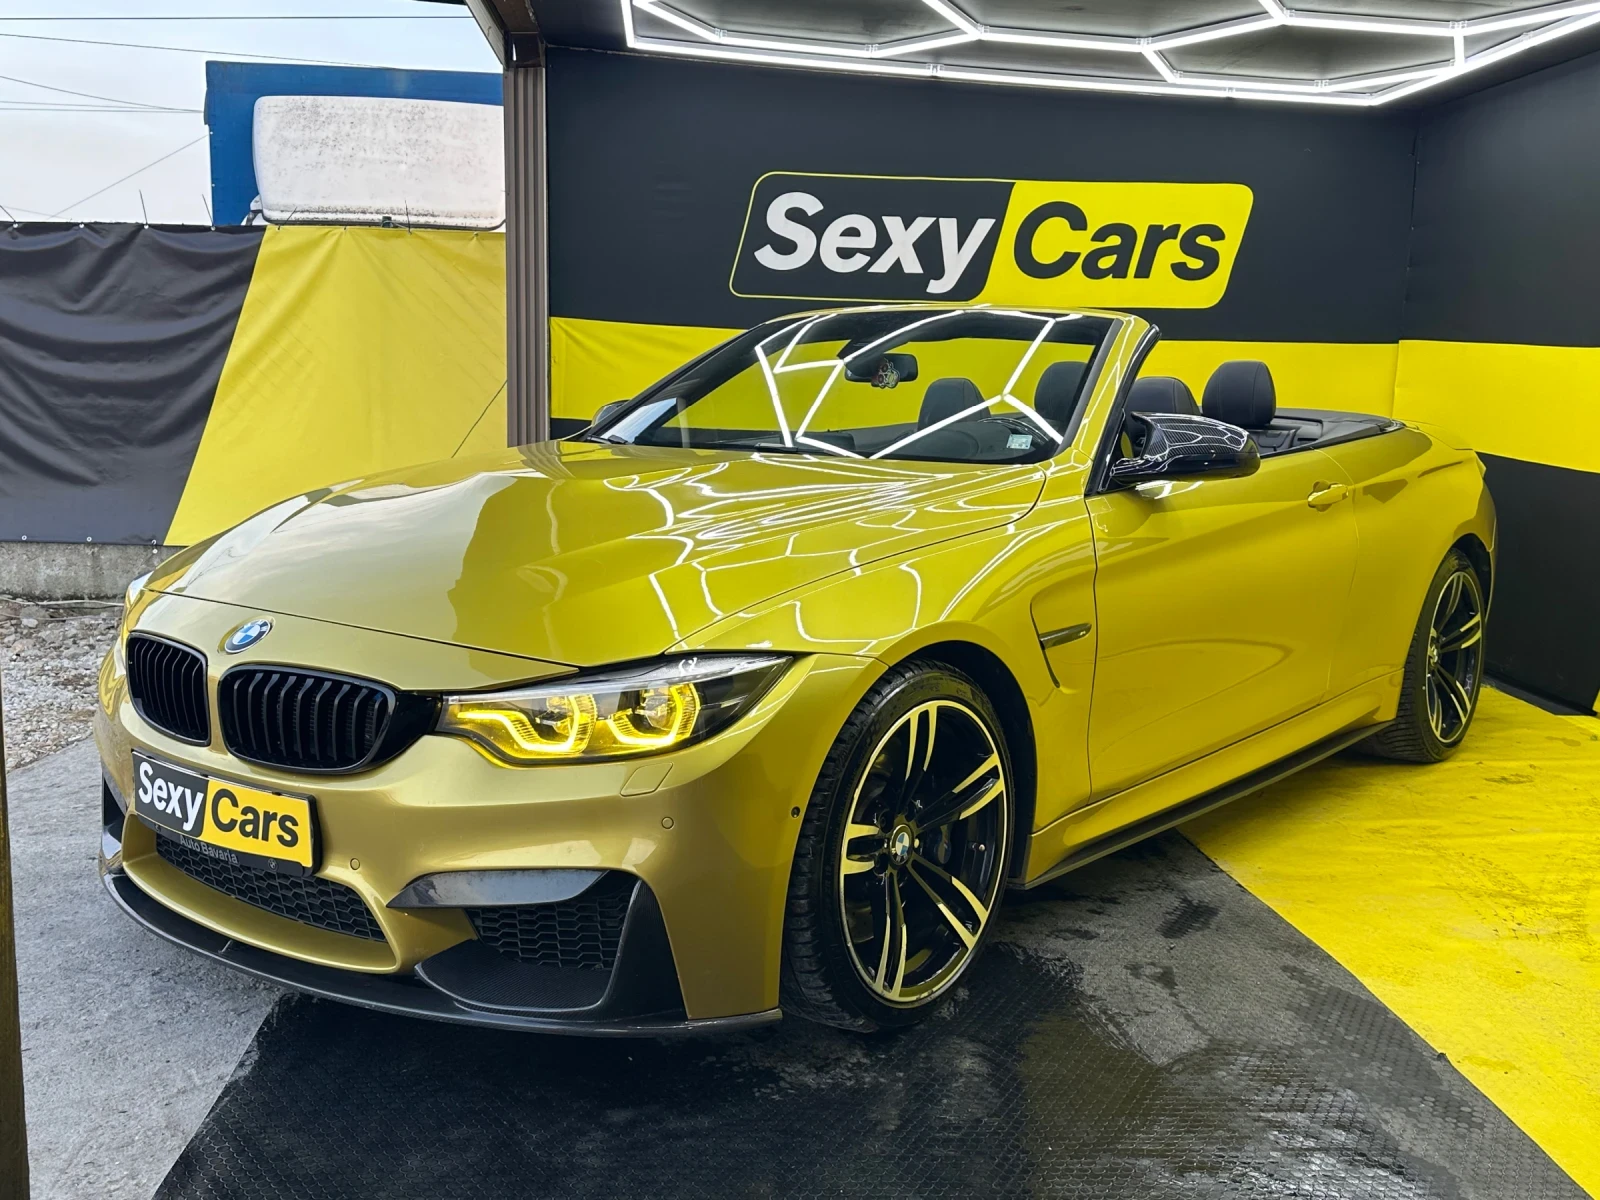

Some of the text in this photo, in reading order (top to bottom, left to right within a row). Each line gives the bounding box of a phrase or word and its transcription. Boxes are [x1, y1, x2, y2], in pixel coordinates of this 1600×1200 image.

[753, 191, 1226, 294] Sexy Cars
[138, 761, 299, 848] Sexy Cars
[180, 837, 238, 864] Auto Bavaria
